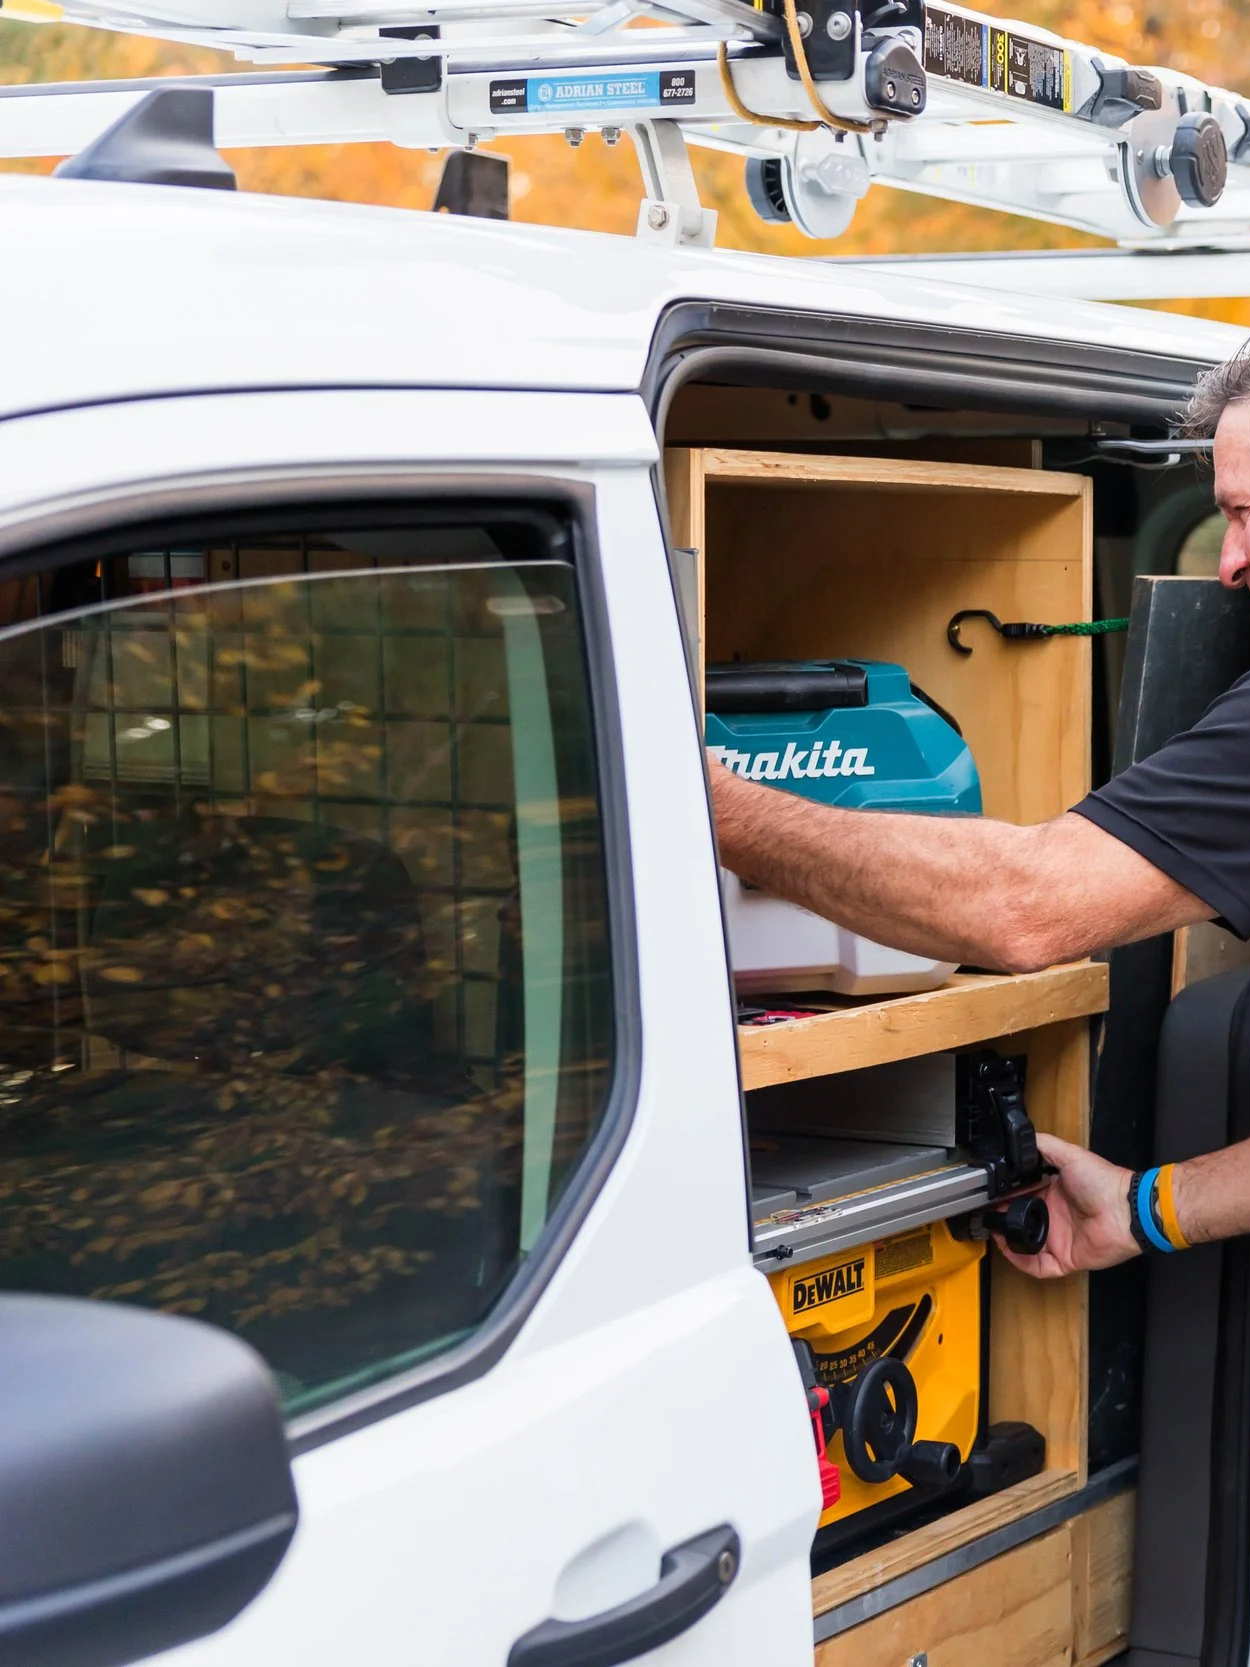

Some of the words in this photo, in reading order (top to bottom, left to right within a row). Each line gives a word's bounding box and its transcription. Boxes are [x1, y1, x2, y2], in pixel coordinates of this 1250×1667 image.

[996, 33, 1005, 64] 300
[671, 77, 685, 87] 800
[492, 88, 526, 97] adriansteel
[555, 83, 604, 98] ADRIAN
[607, 82, 646, 96] STEEL
[662, 87, 694, 98] 677-2726
[820, 1361, 829, 1371] 20
[829, 1361, 838, 1371] 25
